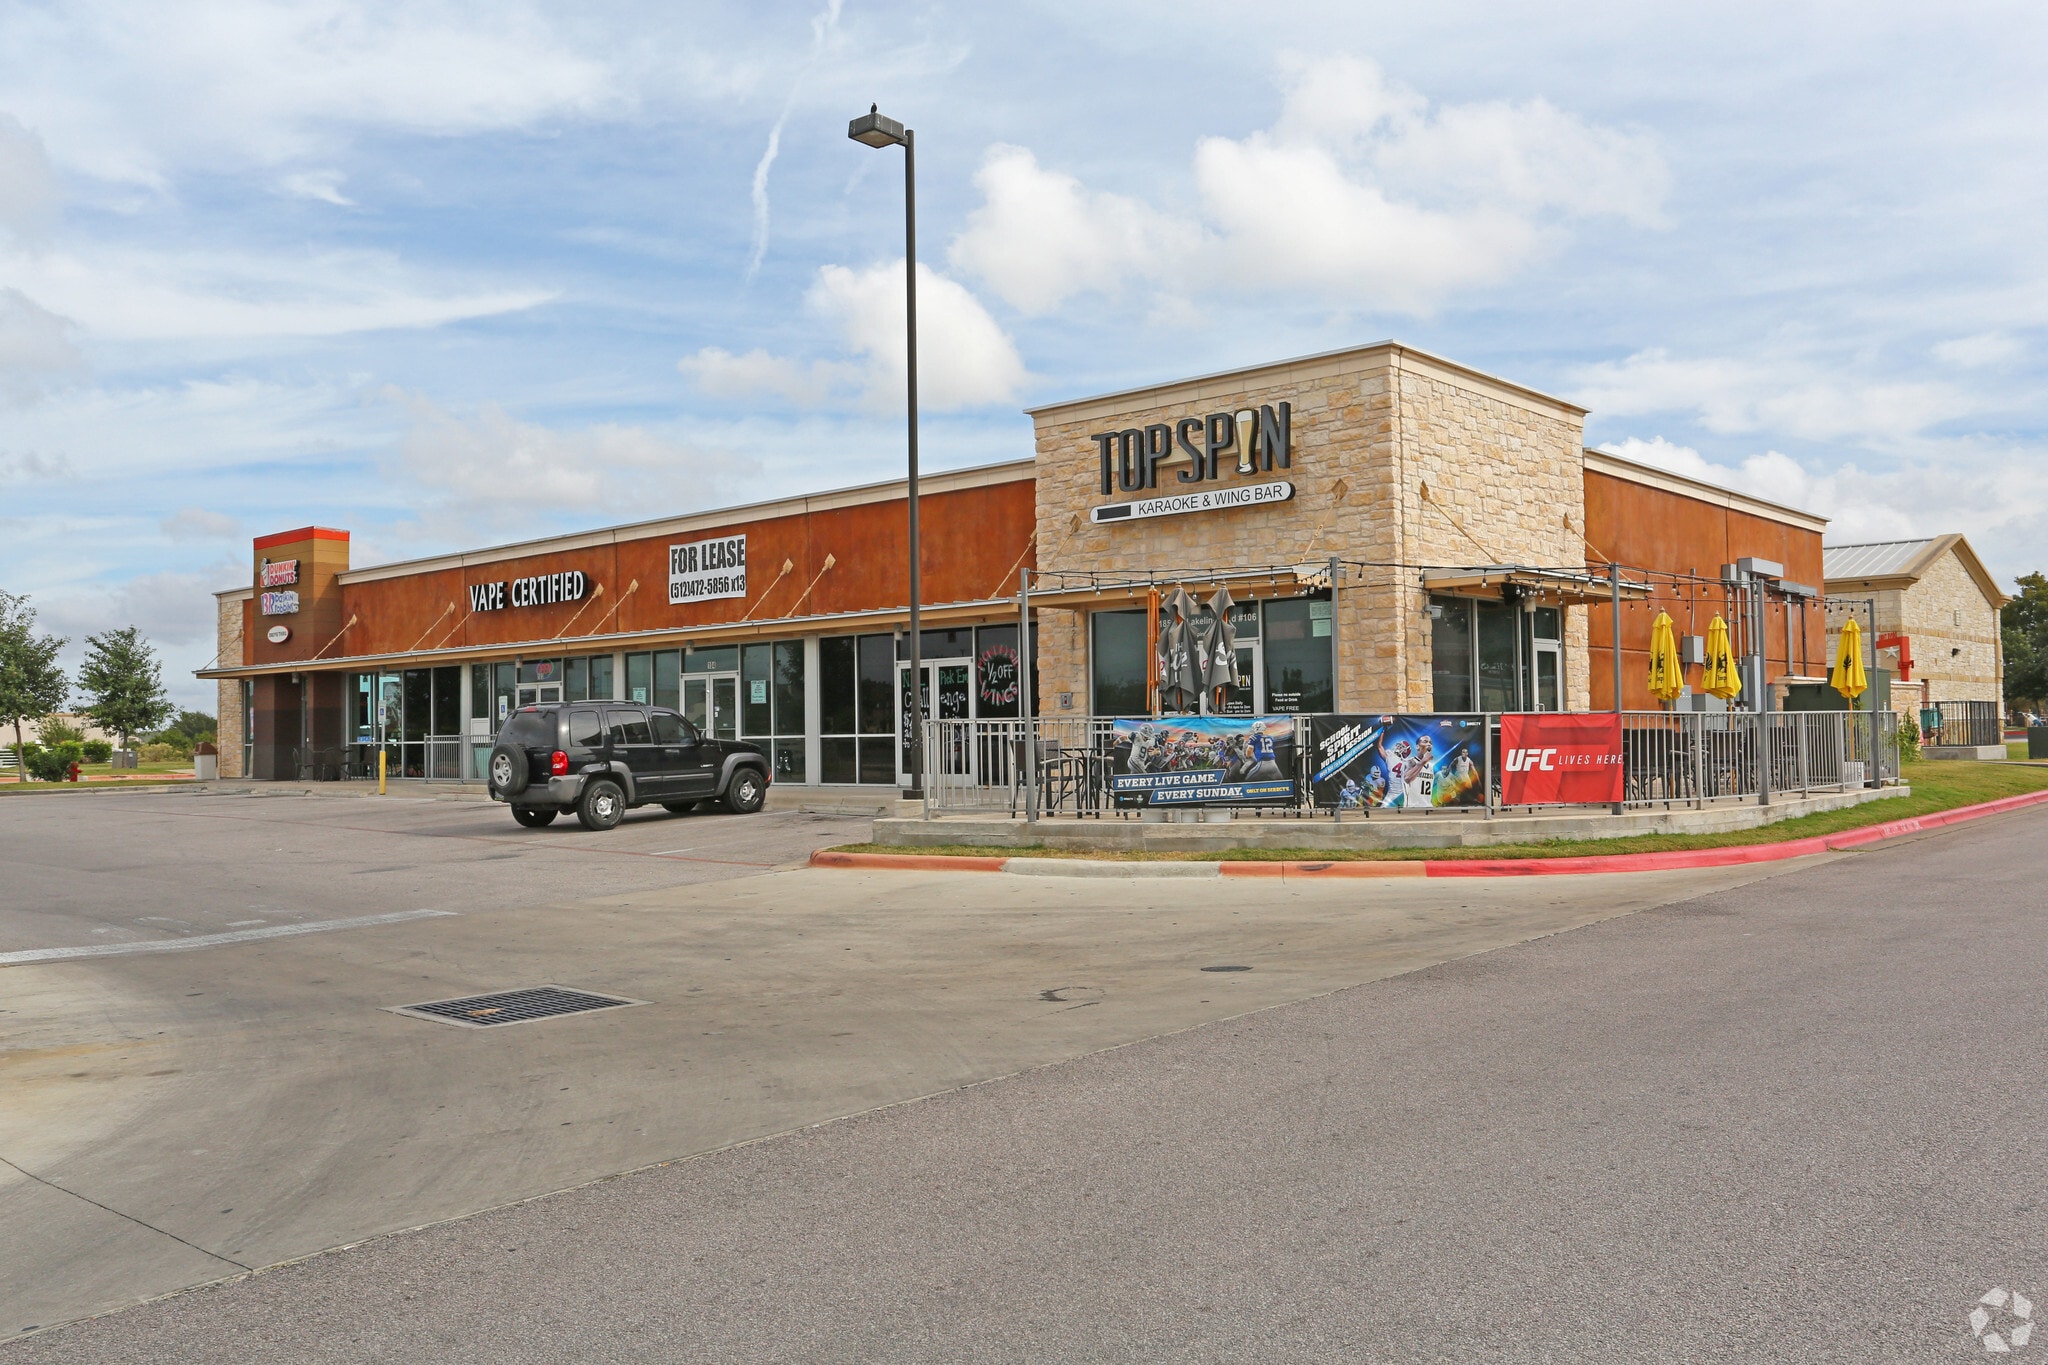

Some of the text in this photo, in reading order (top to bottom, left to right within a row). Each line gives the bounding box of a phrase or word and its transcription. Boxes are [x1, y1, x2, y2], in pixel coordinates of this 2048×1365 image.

[1138, 484, 1283, 515] KARAOKE & WING BAR
[671, 538, 745, 575] FOR LEASE
[269, 572, 295, 585] DONUTS
[670, 574, 745, 599] (512)472-5856 x13
[469, 570, 585, 612] VAPE CERTIFIED
[261, 593, 275, 615] BR
[1238, 613, 1257, 622] #106
[997, 664, 1014, 679] OFF
[980, 680, 1018, 707] WINGS
[1259, 737, 1274, 753] 12
[1320, 724, 1350, 751] SCHOOL
[1321, 753, 1336, 770] NOW
[1337, 747, 1345, 758] IN
[1345, 726, 1372, 752] SESSION
[1327, 723, 1361, 757] SPIRIT
[1505, 748, 1623, 772] UFC LIVES HERE
[1117, 773, 1218, 788] EVERY LIVE GAME.
[1420, 780, 1431, 796] 12
[1157, 789, 1196, 801] EVERY
[1196, 787, 1243, 798] SUNDAY.
